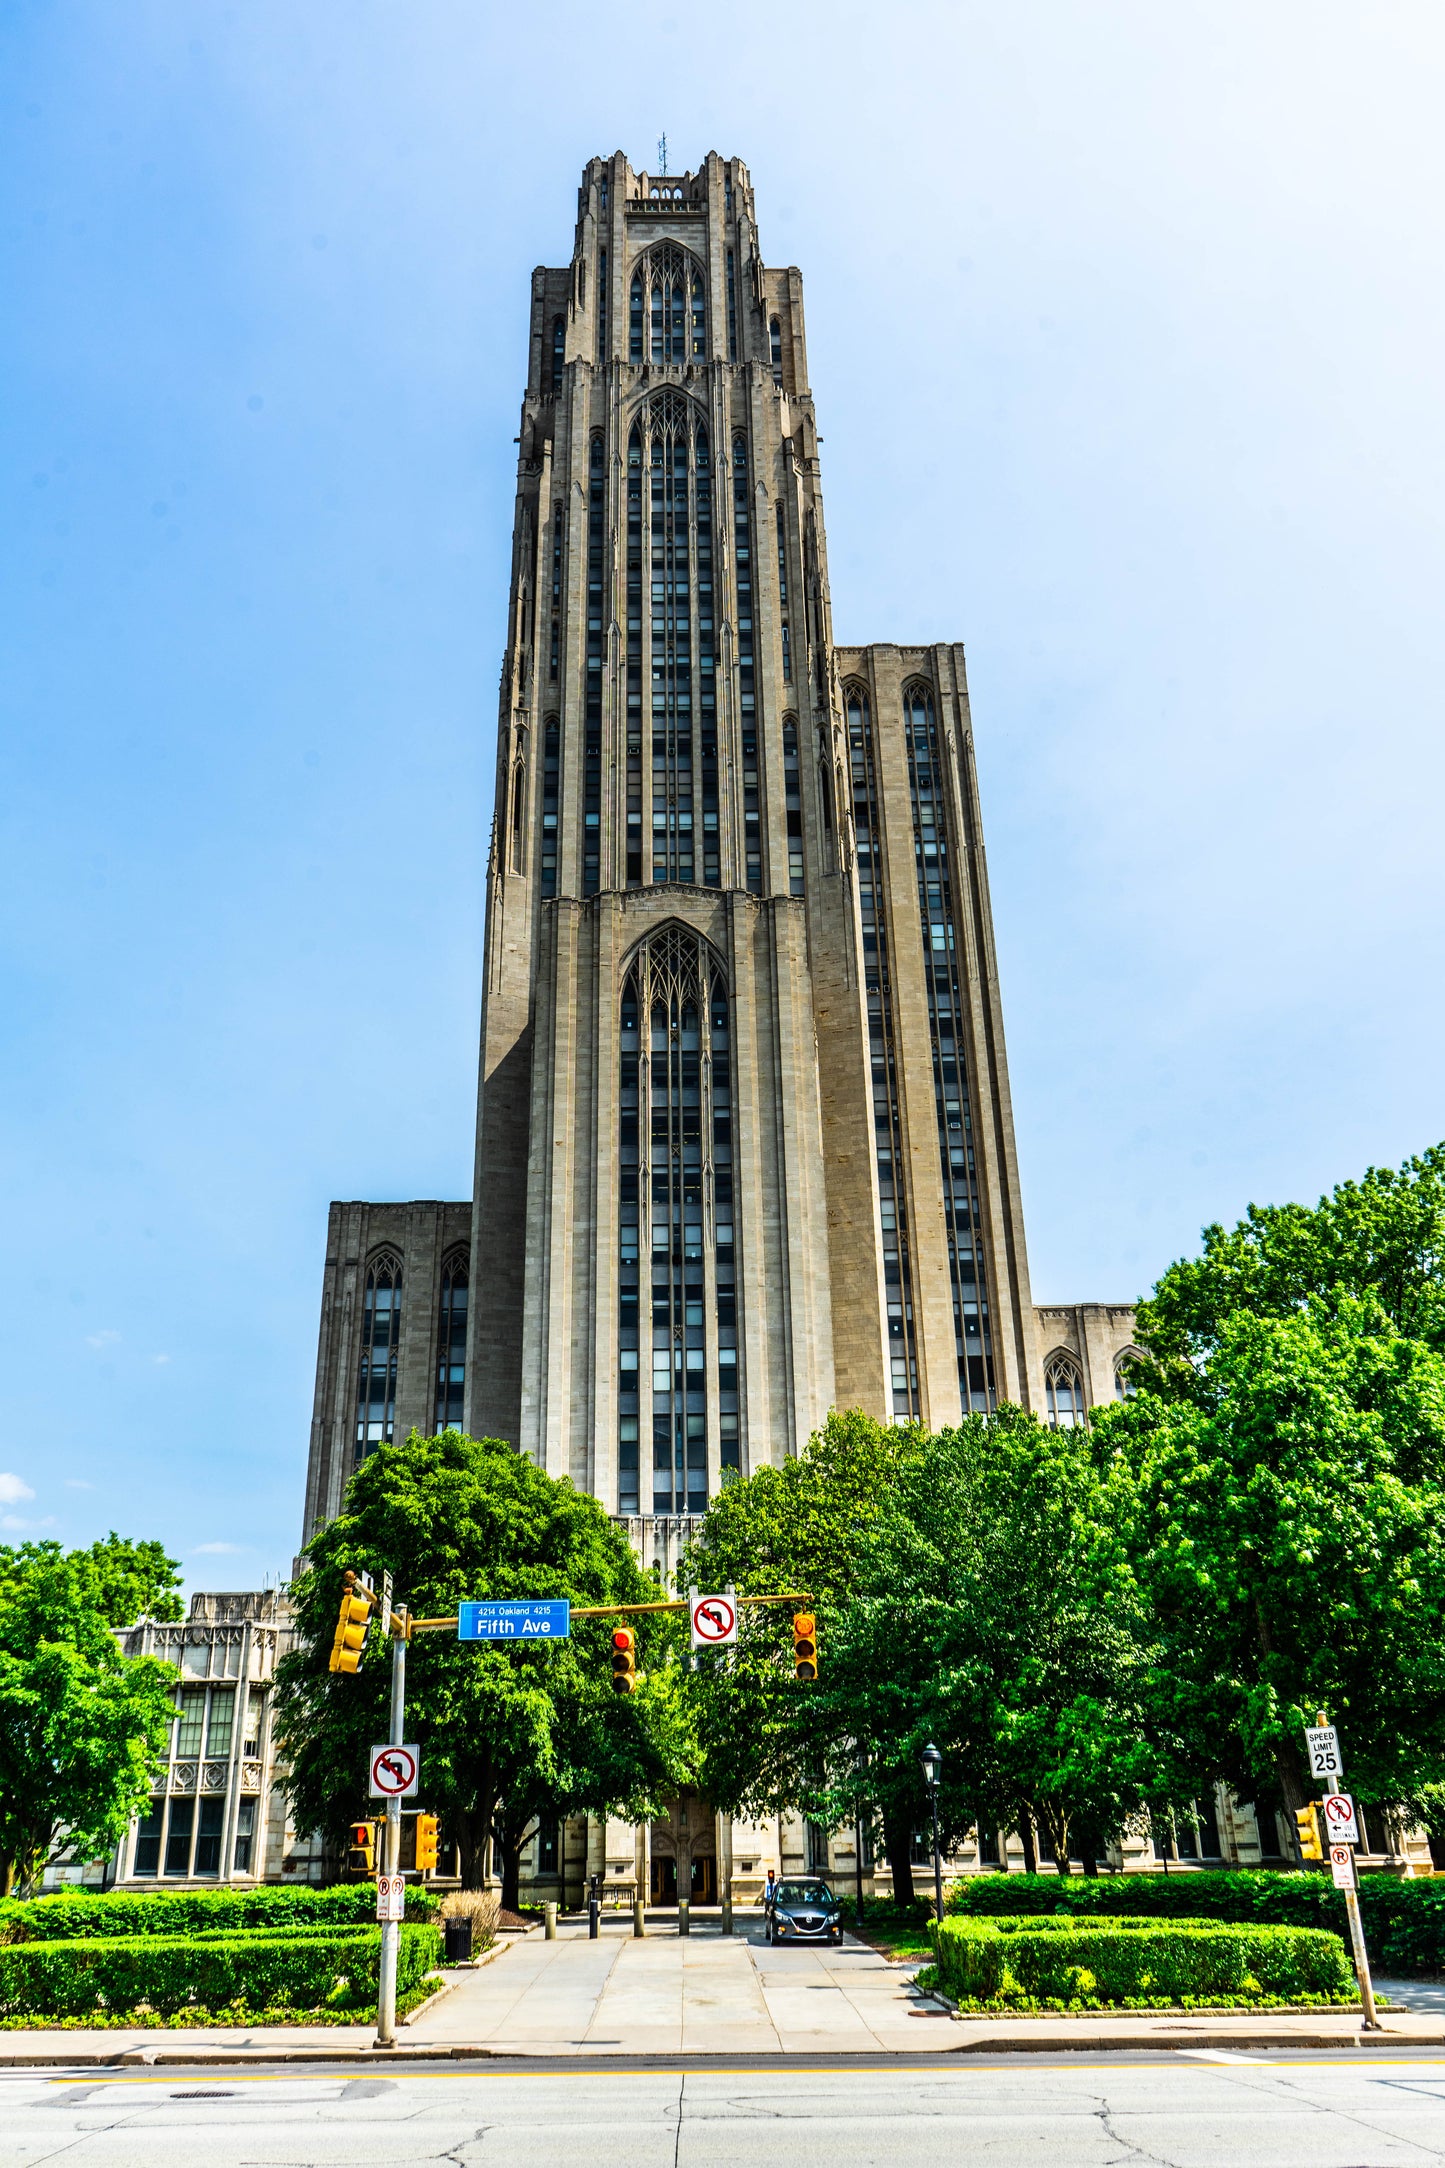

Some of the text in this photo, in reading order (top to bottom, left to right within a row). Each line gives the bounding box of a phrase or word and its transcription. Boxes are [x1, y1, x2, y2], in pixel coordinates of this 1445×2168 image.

[478, 1606, 551, 1616] 4214 Oakland 4215
[477, 1619, 551, 1634] Fifth Ave
[1309, 1732, 1335, 1742] SPEED
[1313, 1743, 1332, 1751] LIMIT
[1315, 1753, 1337, 1771] 25
